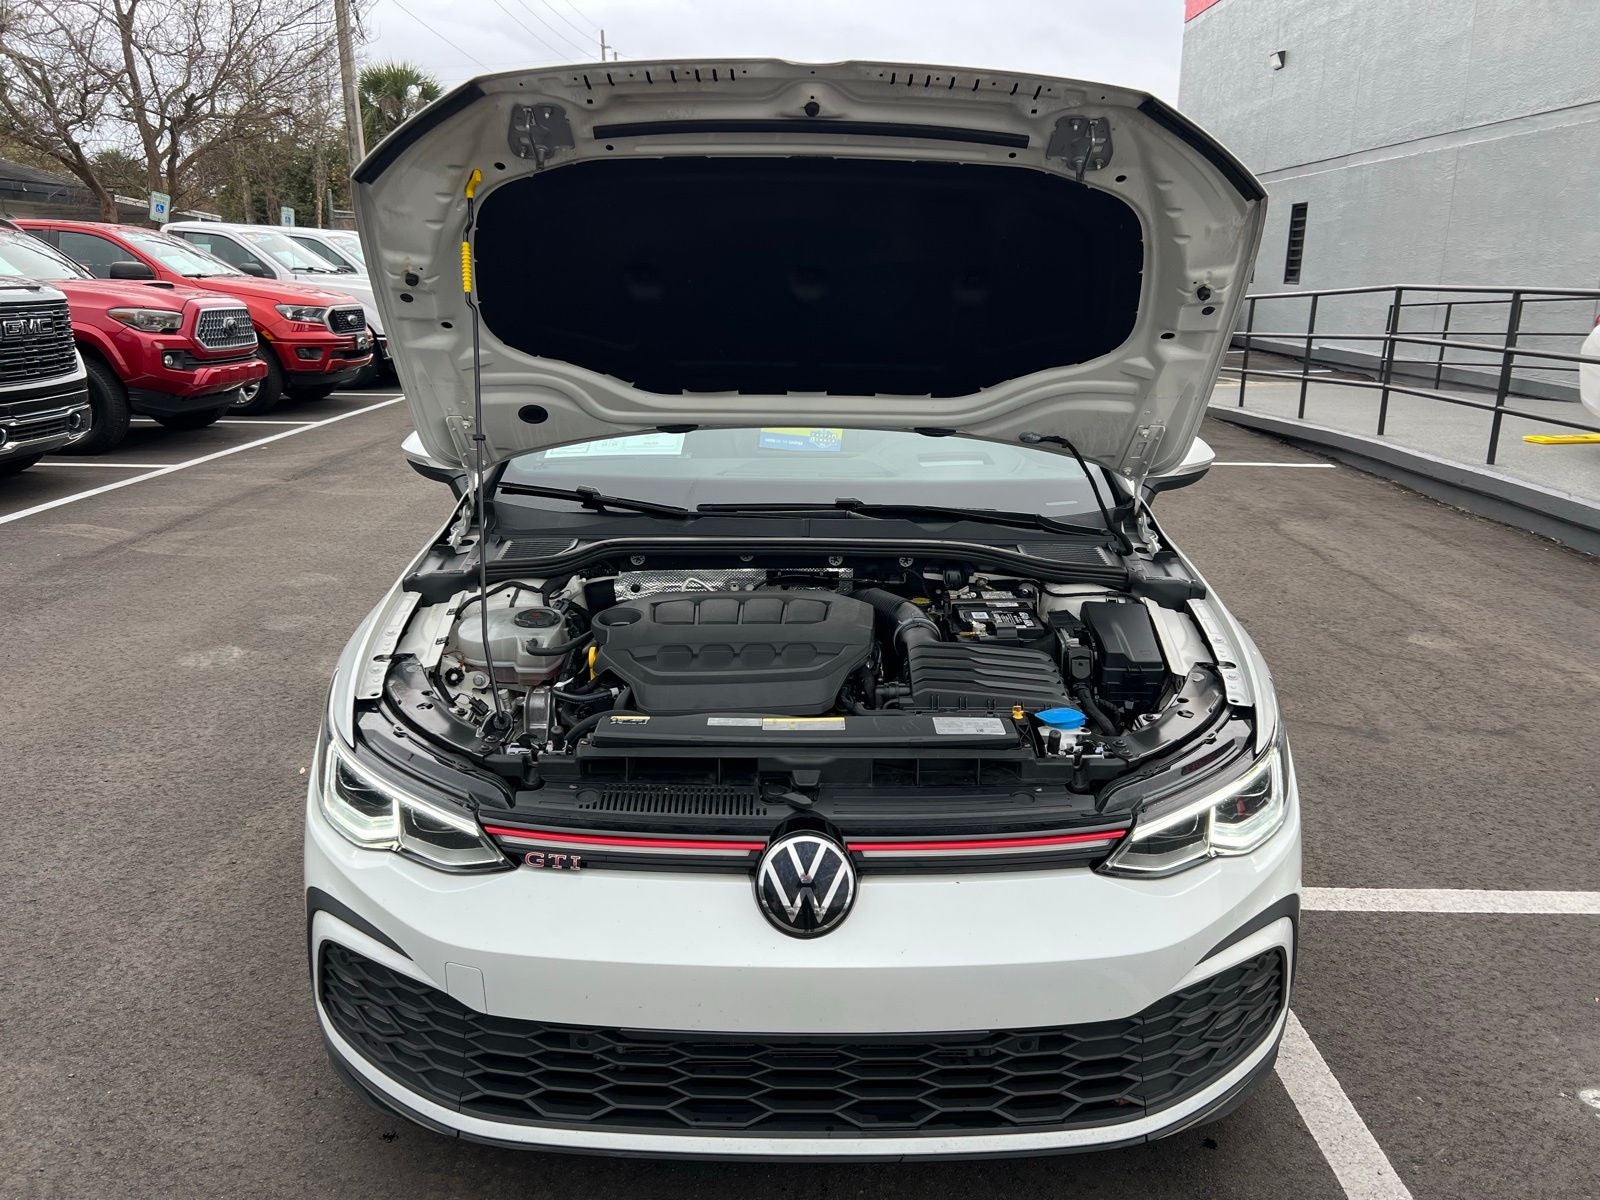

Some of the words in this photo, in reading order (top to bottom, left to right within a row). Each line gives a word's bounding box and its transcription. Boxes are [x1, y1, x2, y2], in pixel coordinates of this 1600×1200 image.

[3, 318, 53, 337] GMC
[525, 851, 581, 871] GTI
[760, 838, 852, 926] VW
